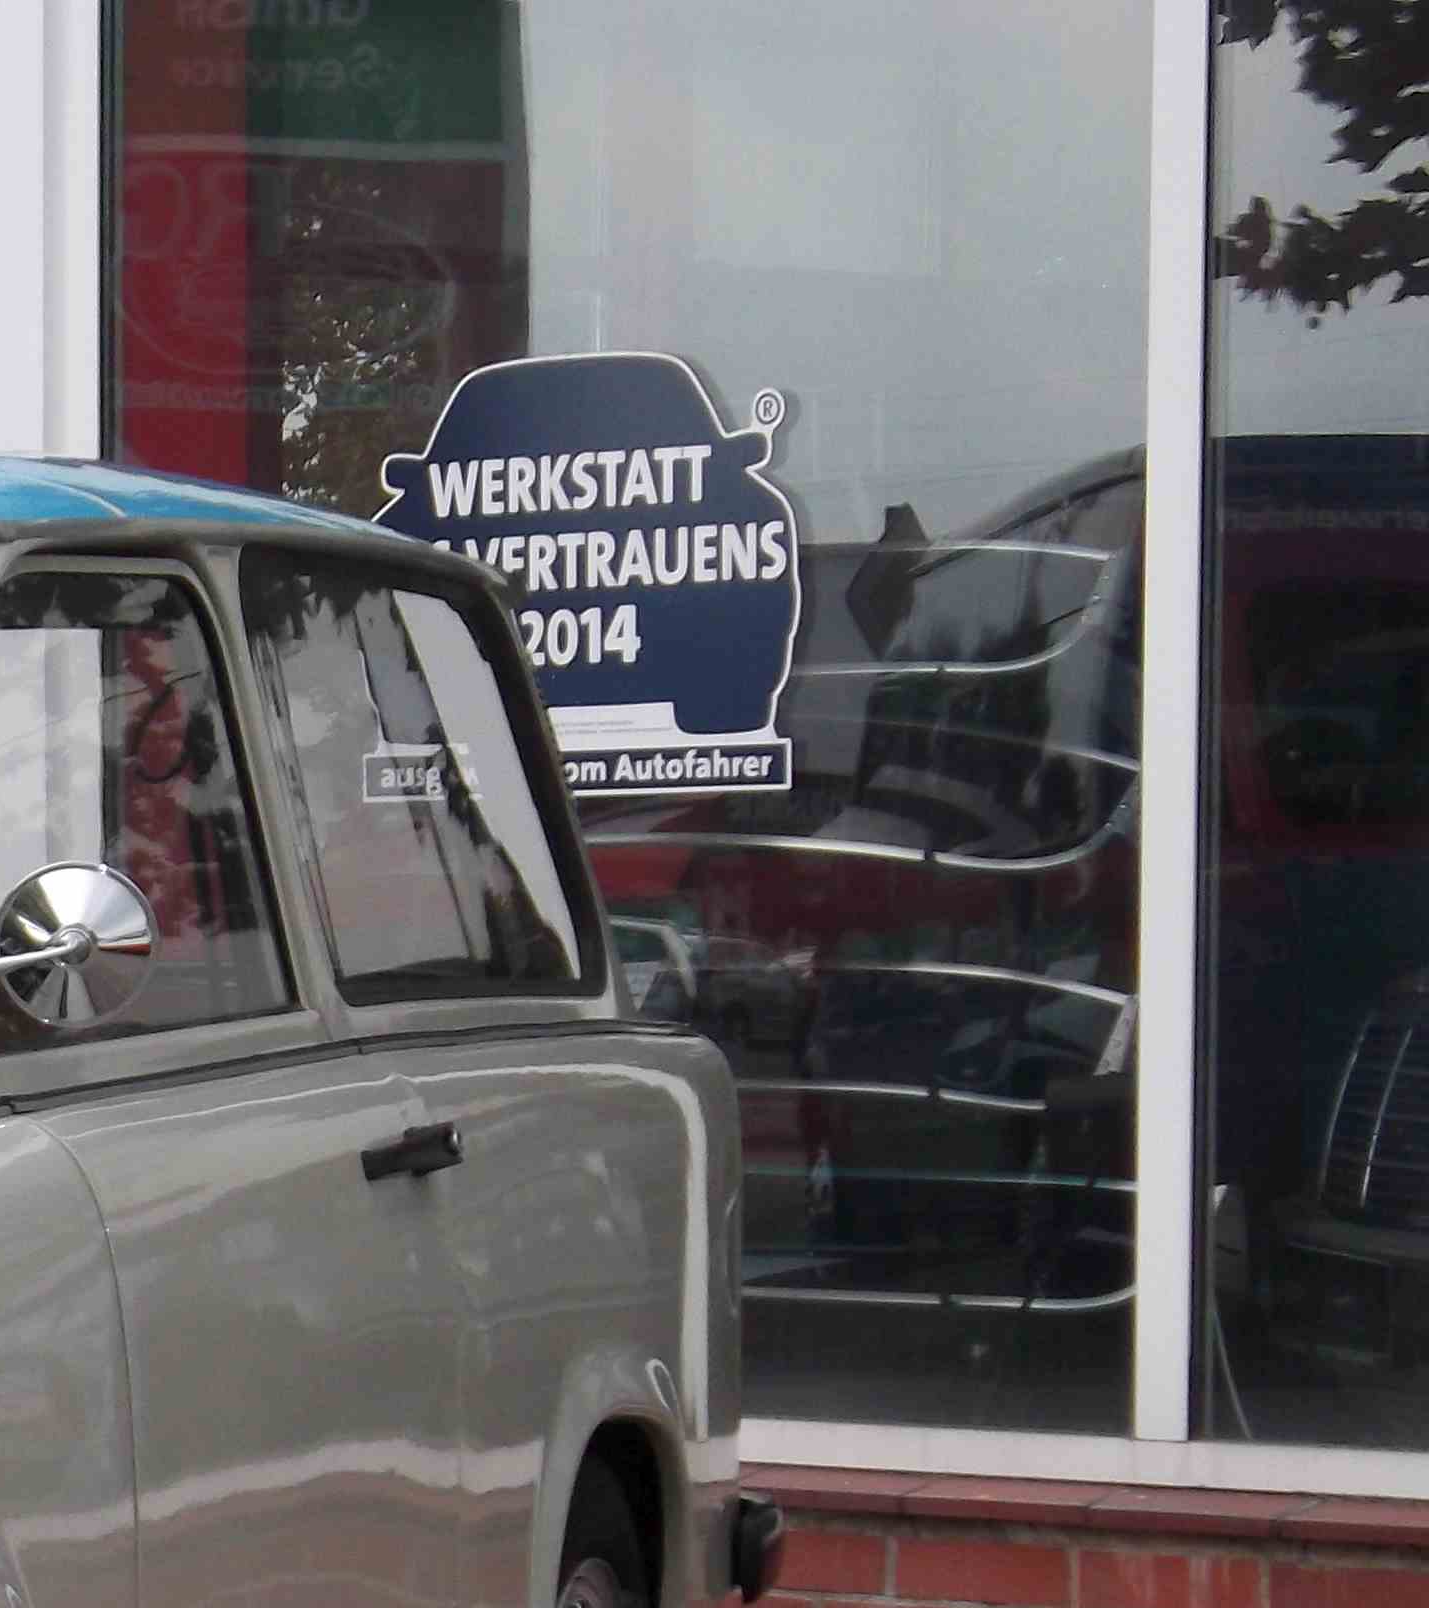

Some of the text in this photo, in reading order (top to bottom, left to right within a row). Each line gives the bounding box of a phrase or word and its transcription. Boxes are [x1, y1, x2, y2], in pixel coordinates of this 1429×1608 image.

[428, 444, 712, 518] WERKSTATT
[521, 604, 642, 666] 2014
[564, 762, 607, 783] om
[614, 750, 773, 782] Autofahrer
